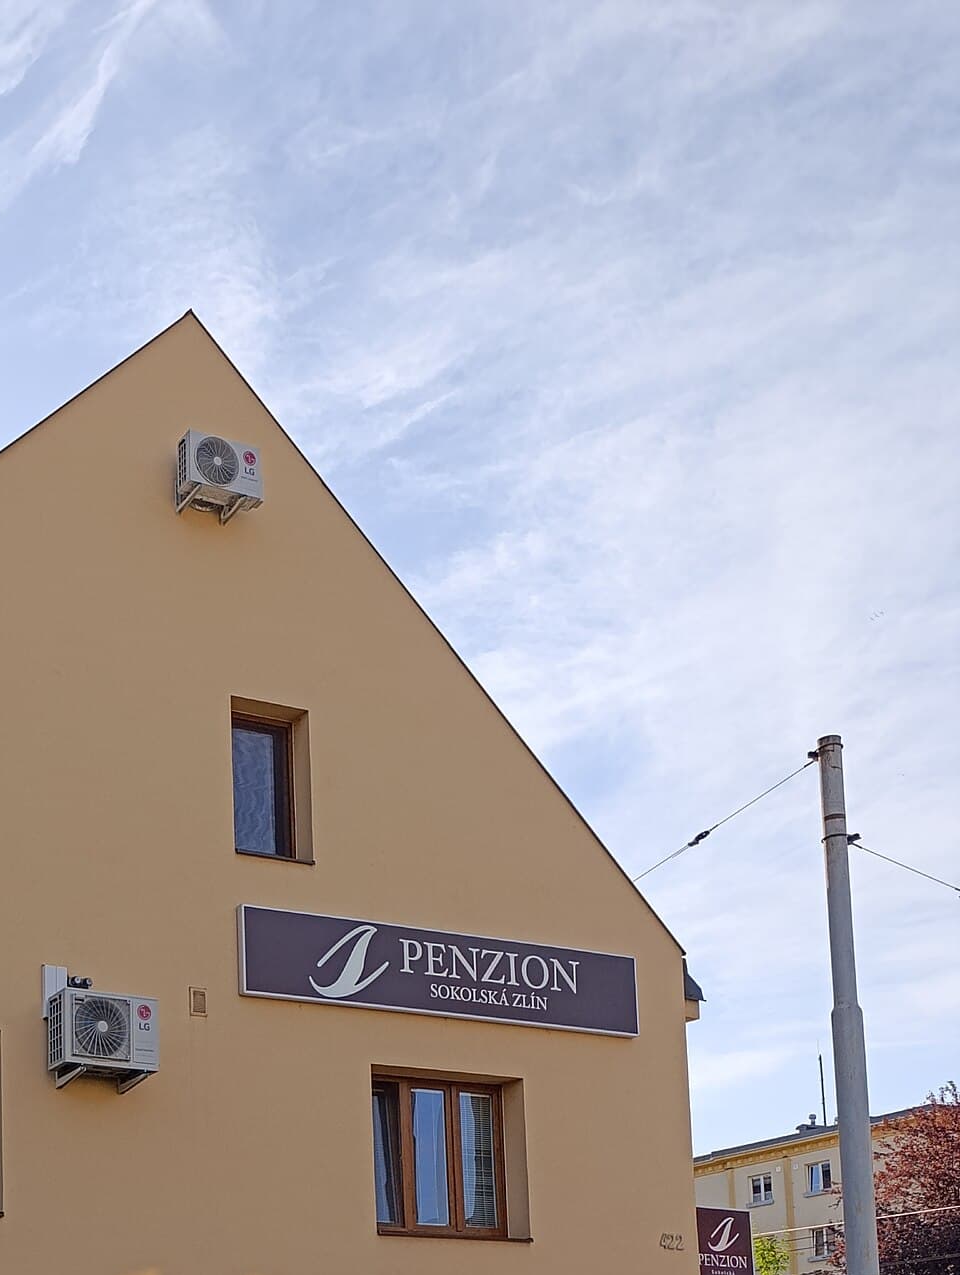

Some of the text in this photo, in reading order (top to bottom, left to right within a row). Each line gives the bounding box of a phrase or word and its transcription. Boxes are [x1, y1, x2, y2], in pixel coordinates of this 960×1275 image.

[244, 467, 255, 476] LG
[398, 938, 580, 994] PENZION
[429, 983, 548, 1011] SOKOLSKÁ ZLÍN
[138, 1022, 151, 1031] LG
[659, 1233, 685, 1251] 422
[698, 1253, 748, 1269] PENZION
